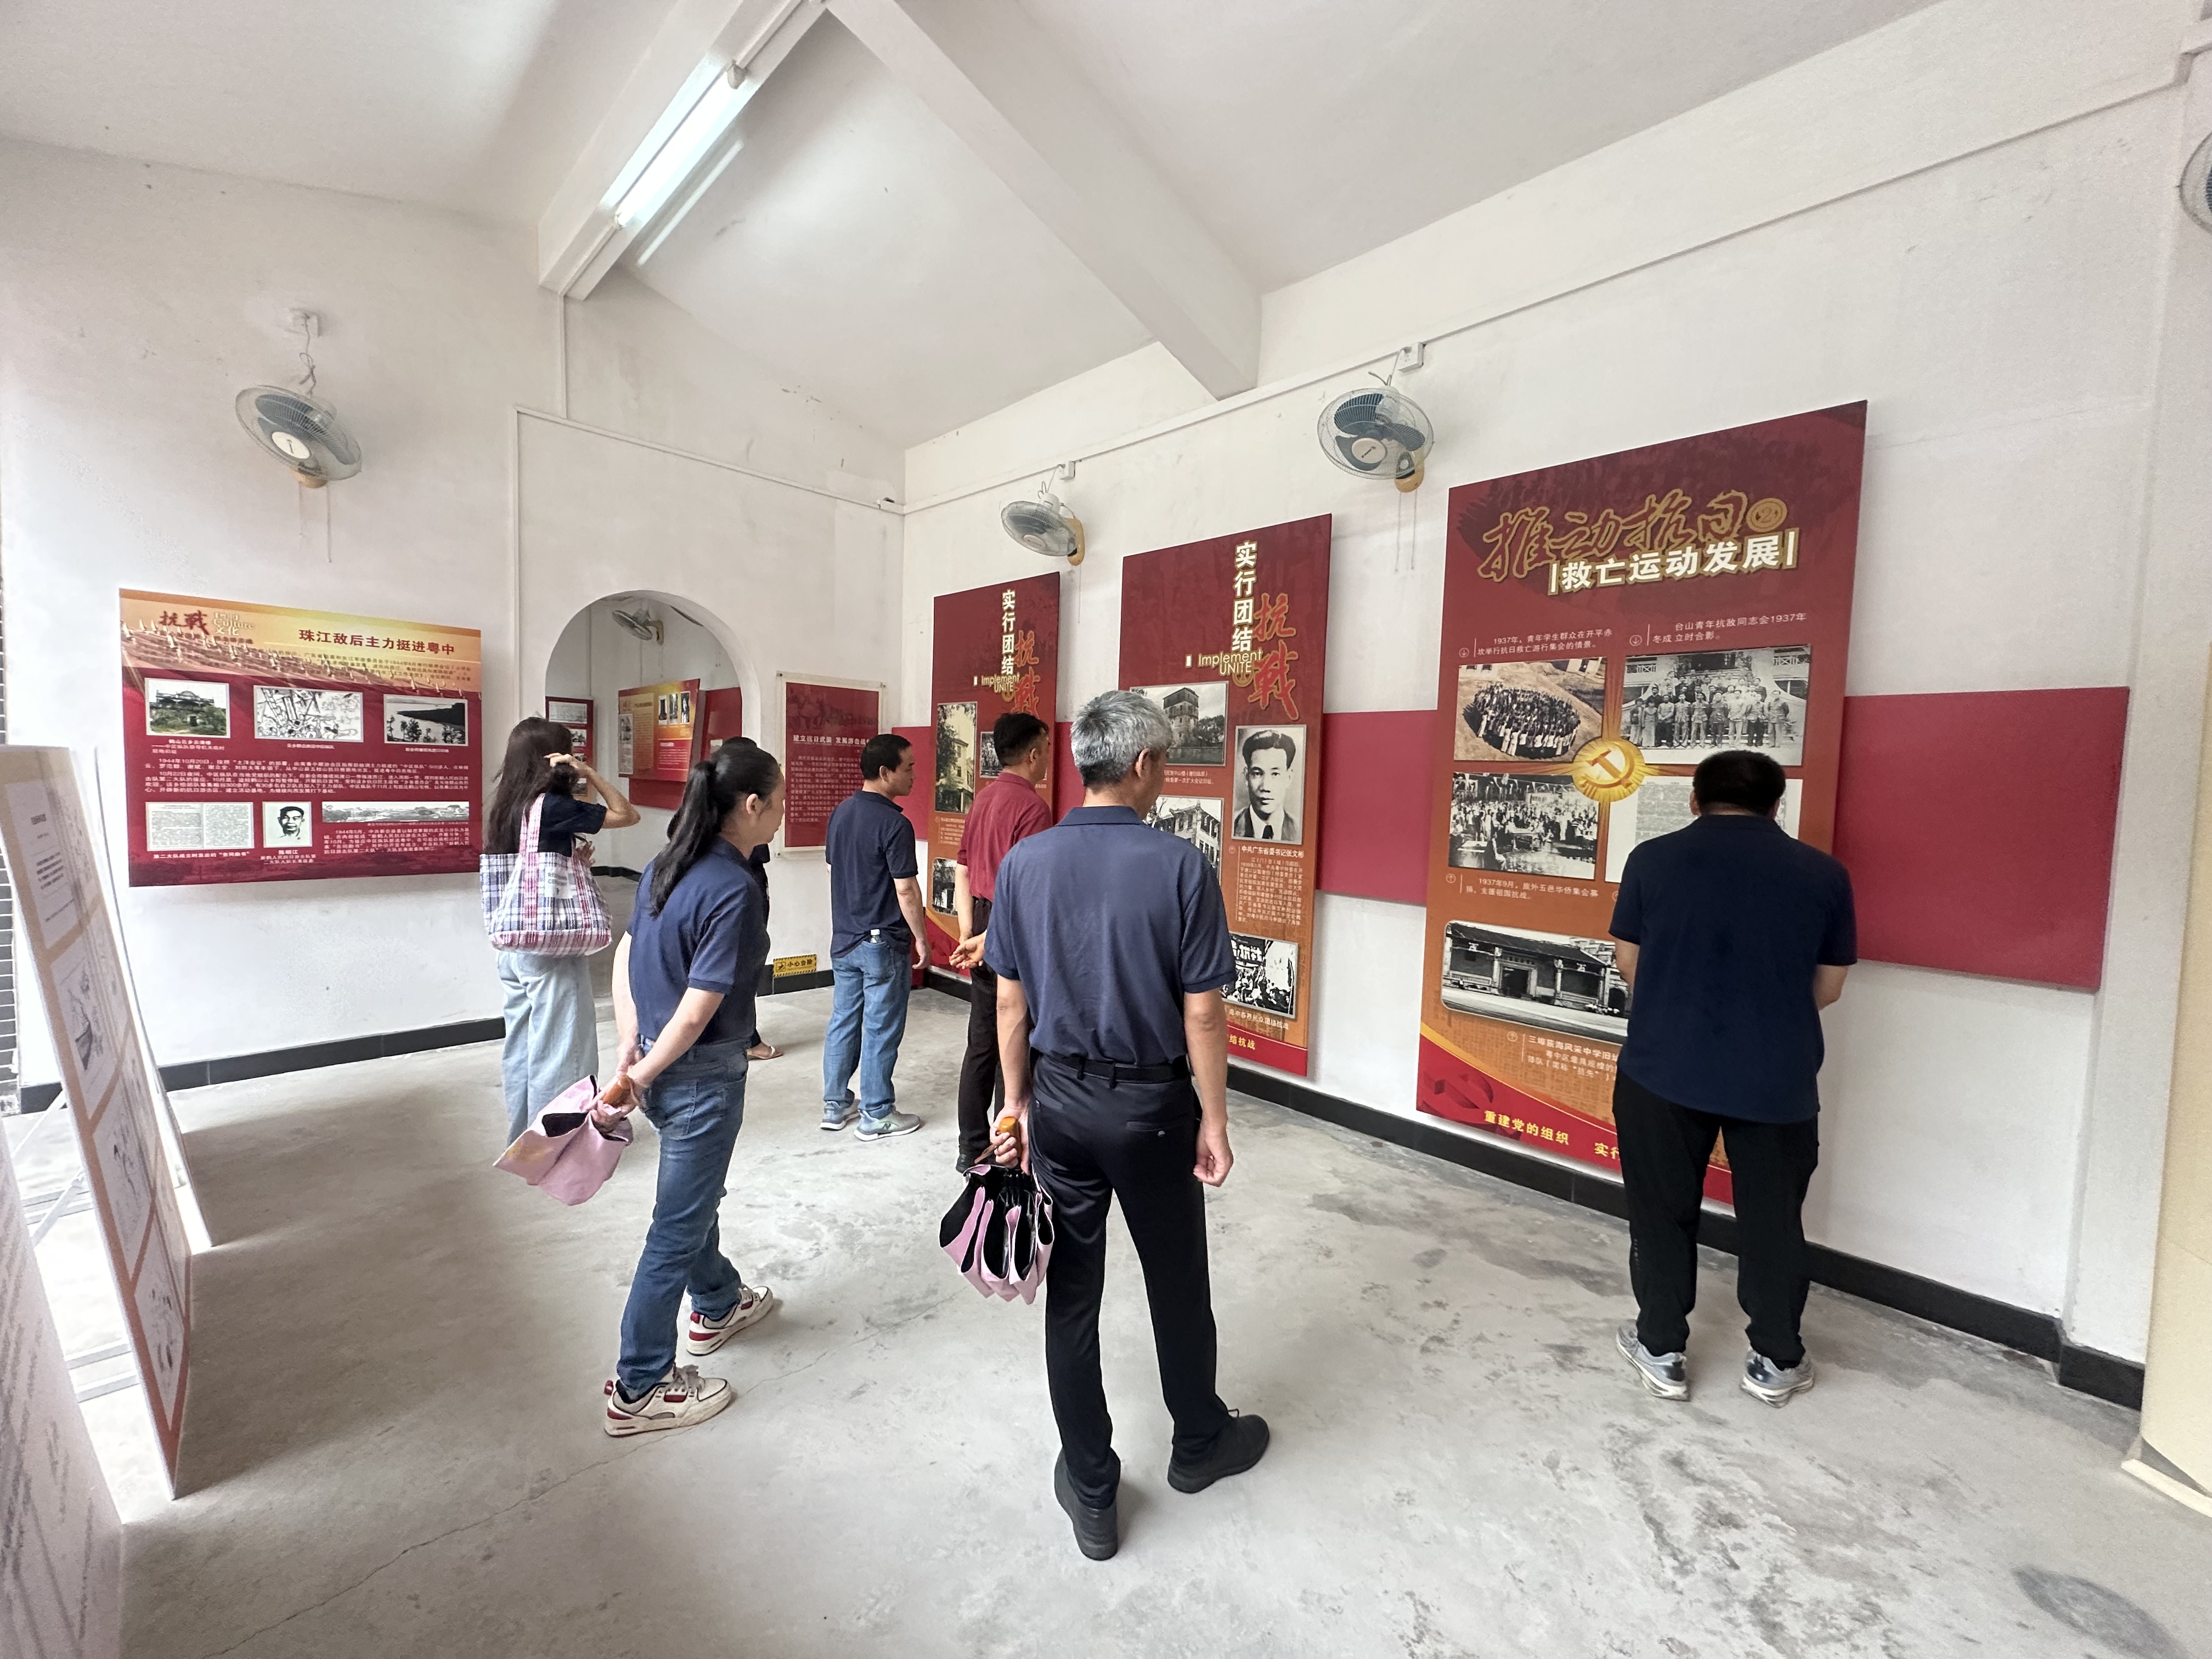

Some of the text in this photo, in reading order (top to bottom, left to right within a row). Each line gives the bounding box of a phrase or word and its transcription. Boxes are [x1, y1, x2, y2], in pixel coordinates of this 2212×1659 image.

[1561, 535, 1780, 591] 救亡运动发展
[1232, 541, 1257, 652] 实行团结
[213, 618, 256, 630] Culture
[1001, 589, 1015, 675] 实行团结
[1675, 613, 1807, 632] 台山青年抗敌同志会1937年
[298, 629, 455, 656] 珠江敌后主力挺进粤中
[1198, 647, 1262, 667] Implement
[1219, 661, 1252, 675] UNITE
[981, 673, 1020, 687] Implement
[994, 682, 1014, 692] UNITE
[793, 734, 832, 743] 建立抗日武装
[836, 736, 871, 746] 发展游击战
[1241, 845, 1305, 859] 中共广东省委书记张文彬
[1545, 1049, 1617, 1073] 粤中区最具规模的
[1484, 1110, 1570, 1146] 重建党的组织
